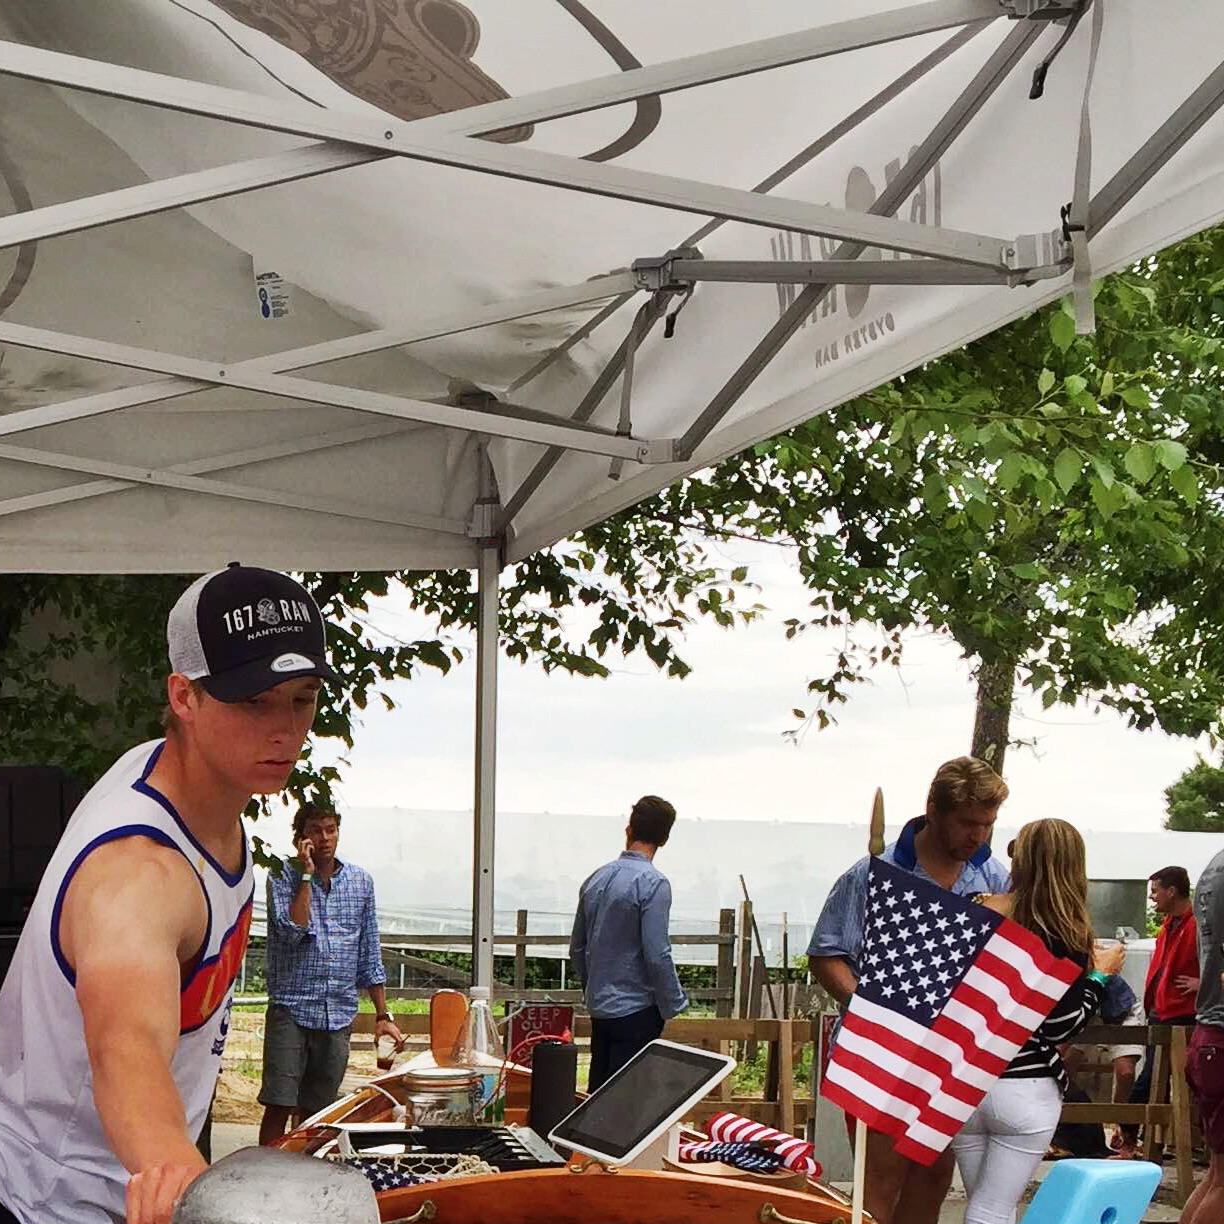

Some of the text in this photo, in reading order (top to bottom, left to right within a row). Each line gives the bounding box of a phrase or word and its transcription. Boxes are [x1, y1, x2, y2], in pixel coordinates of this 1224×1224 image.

[223, 599, 312, 634] 167 RAW
[247, 625, 304, 641] NANTUCKET
